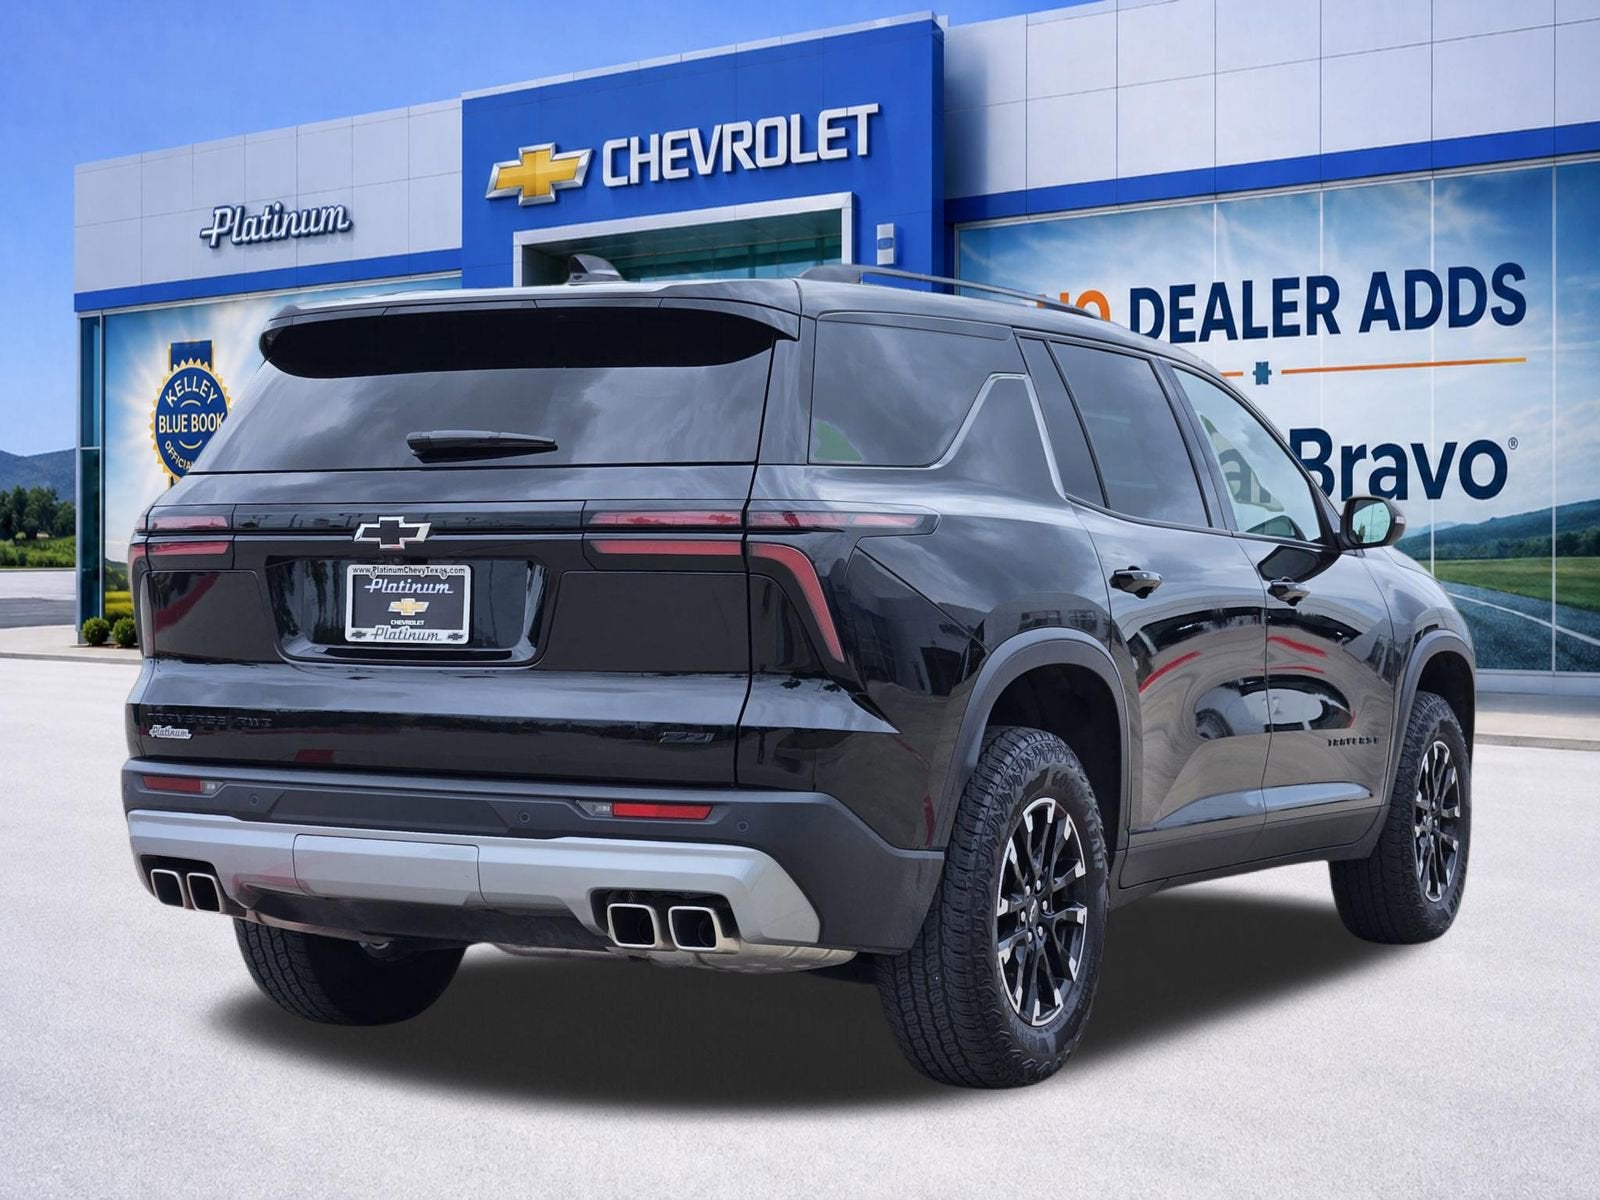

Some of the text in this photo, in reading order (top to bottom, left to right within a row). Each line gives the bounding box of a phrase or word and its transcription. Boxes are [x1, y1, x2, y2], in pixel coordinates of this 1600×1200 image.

[602, 103, 879, 188] CHEVROLET
[200, 201, 353, 248] Platinum
[1129, 275, 1341, 345] DEALER
[1359, 262, 1527, 332] ADDS
[165, 375, 218, 407] KELLEY
[159, 412, 225, 434] BLUE BOOK
[364, 578, 454, 594] Platinum
[371, 626, 443, 641] Platinum
